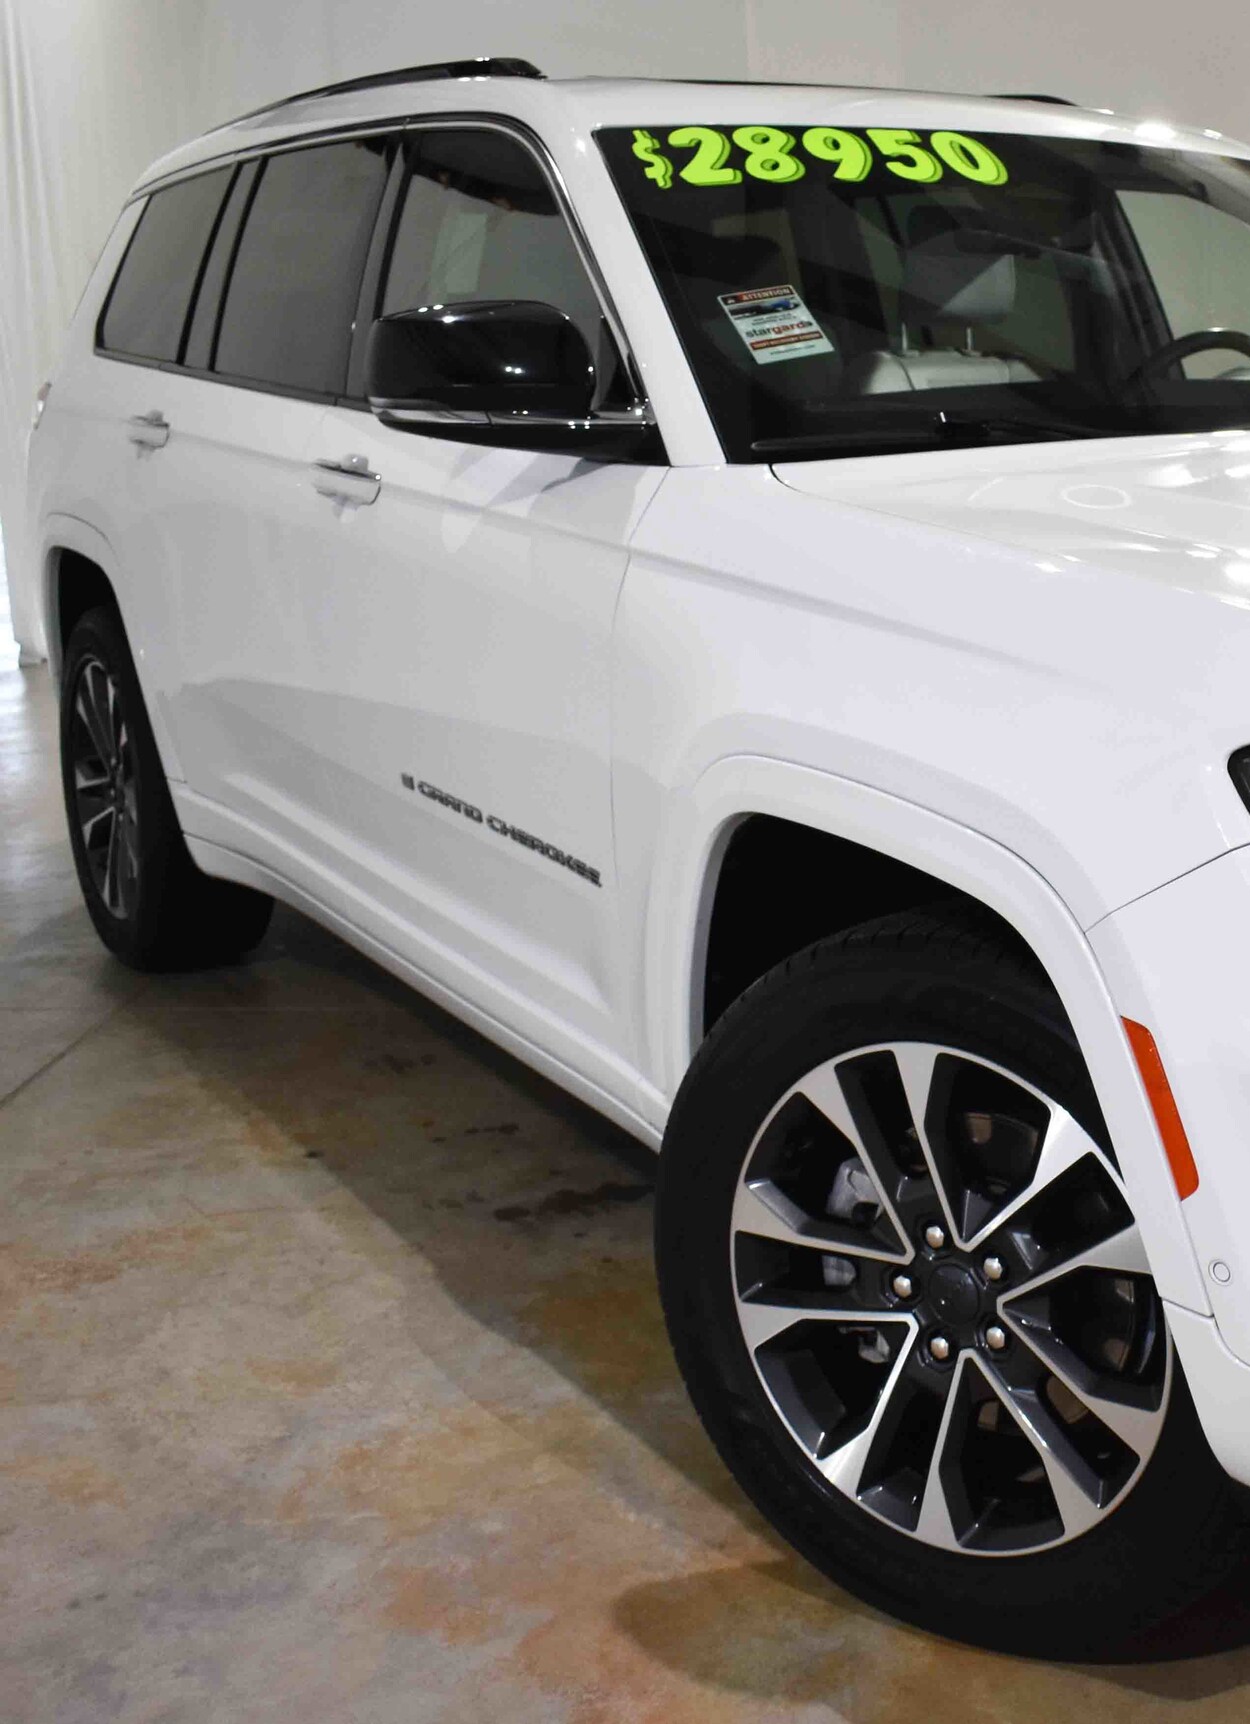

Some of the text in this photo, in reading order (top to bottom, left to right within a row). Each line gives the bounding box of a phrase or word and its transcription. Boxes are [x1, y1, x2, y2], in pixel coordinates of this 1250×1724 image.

[632, 126, 1008, 189] $28950
[417, 780, 602, 888] GRAND CHEROKEE
